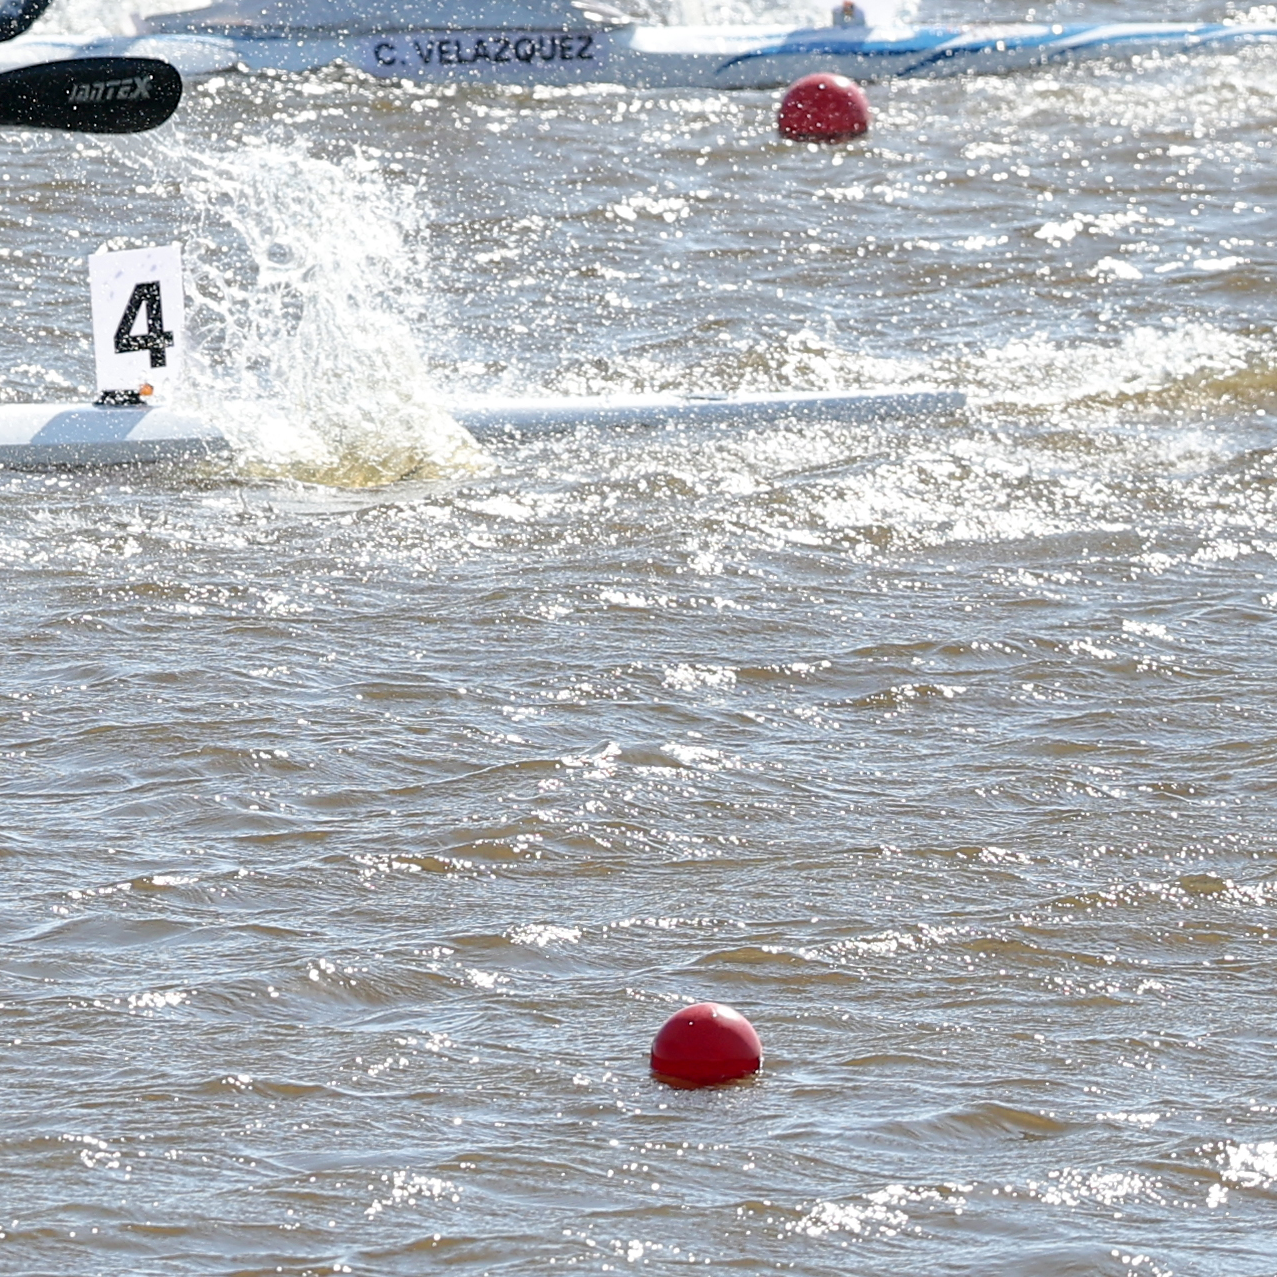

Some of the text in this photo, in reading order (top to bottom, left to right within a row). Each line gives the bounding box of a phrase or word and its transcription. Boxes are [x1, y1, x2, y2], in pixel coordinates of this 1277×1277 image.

[374, 34, 594, 66] C. VELAZQUEZ
[114, 280, 175, 369] 4
